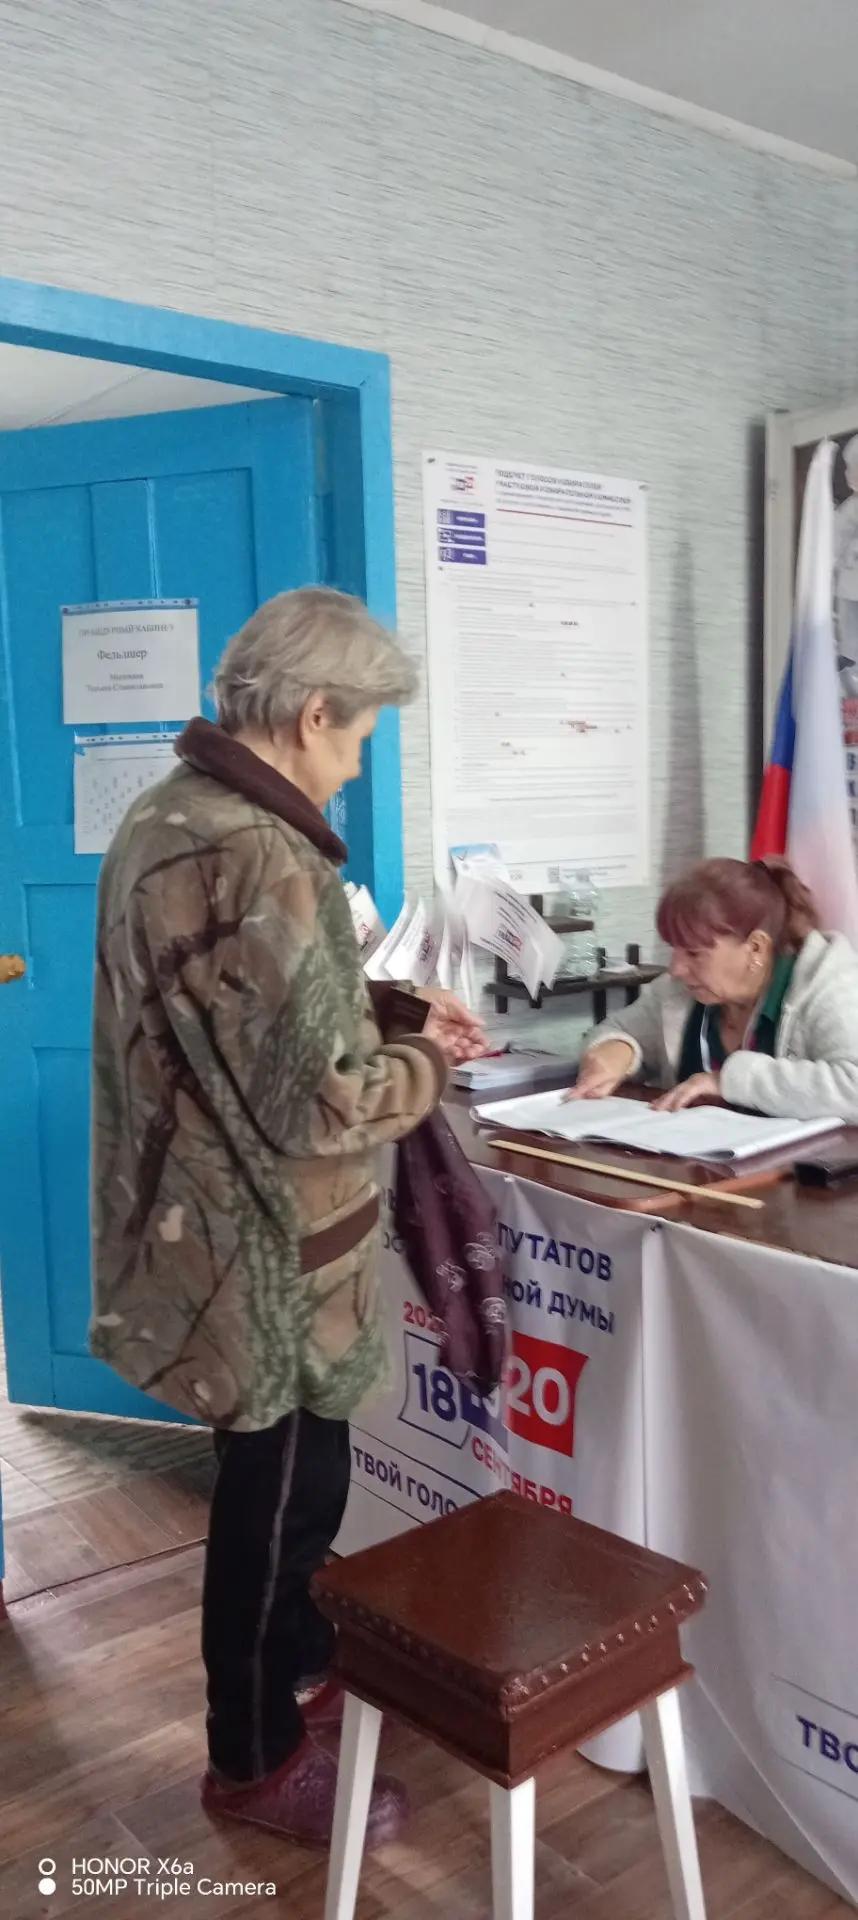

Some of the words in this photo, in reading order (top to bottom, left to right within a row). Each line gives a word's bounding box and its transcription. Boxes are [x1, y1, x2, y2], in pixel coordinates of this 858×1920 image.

[548, 1290, 616, 1334] ДУМЫ
[411, 1362, 457, 1423] 18
[507, 1354, 570, 1427] 20
[352, 1445, 402, 1492] ТВОЙ
